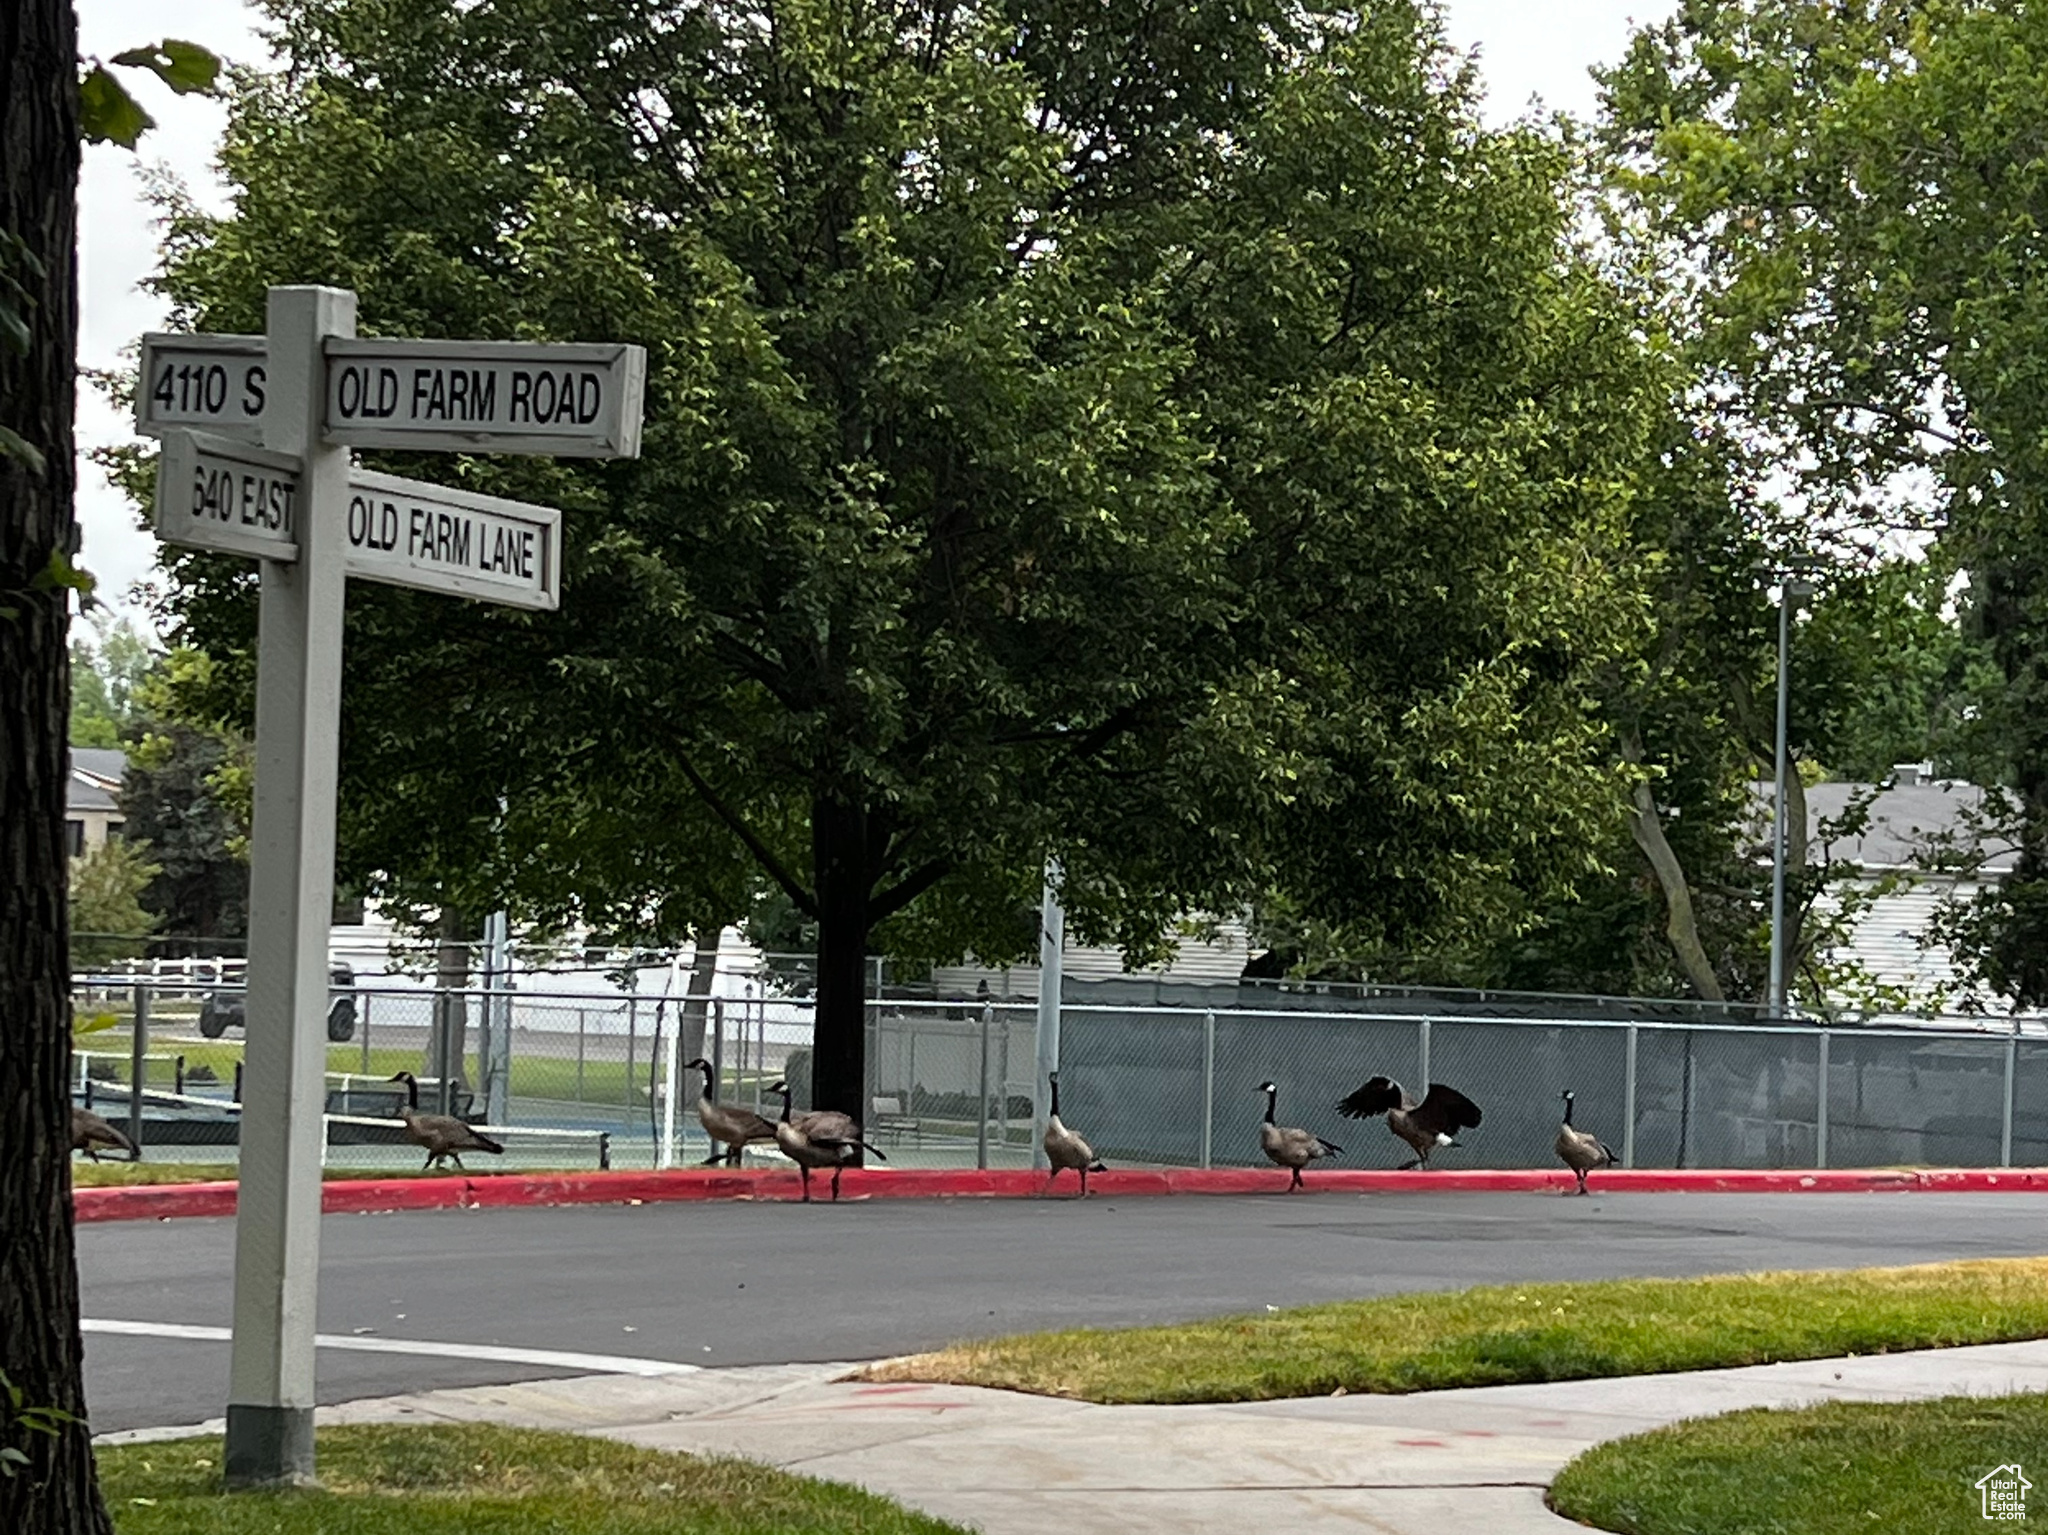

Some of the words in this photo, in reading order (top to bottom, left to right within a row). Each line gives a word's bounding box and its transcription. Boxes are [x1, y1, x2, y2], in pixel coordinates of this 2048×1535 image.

[154, 363, 228, 413] 4110
[242, 365, 266, 415] S
[339, 367, 397, 419] OLD
[411, 368, 497, 421] FARM
[510, 370, 601, 424] ROAD
[192, 466, 234, 522] 640
[241, 477, 294, 532] EAST
[349, 496, 398, 551] OLD
[409, 508, 471, 566] FARM
[480, 523, 534, 579] LANE
